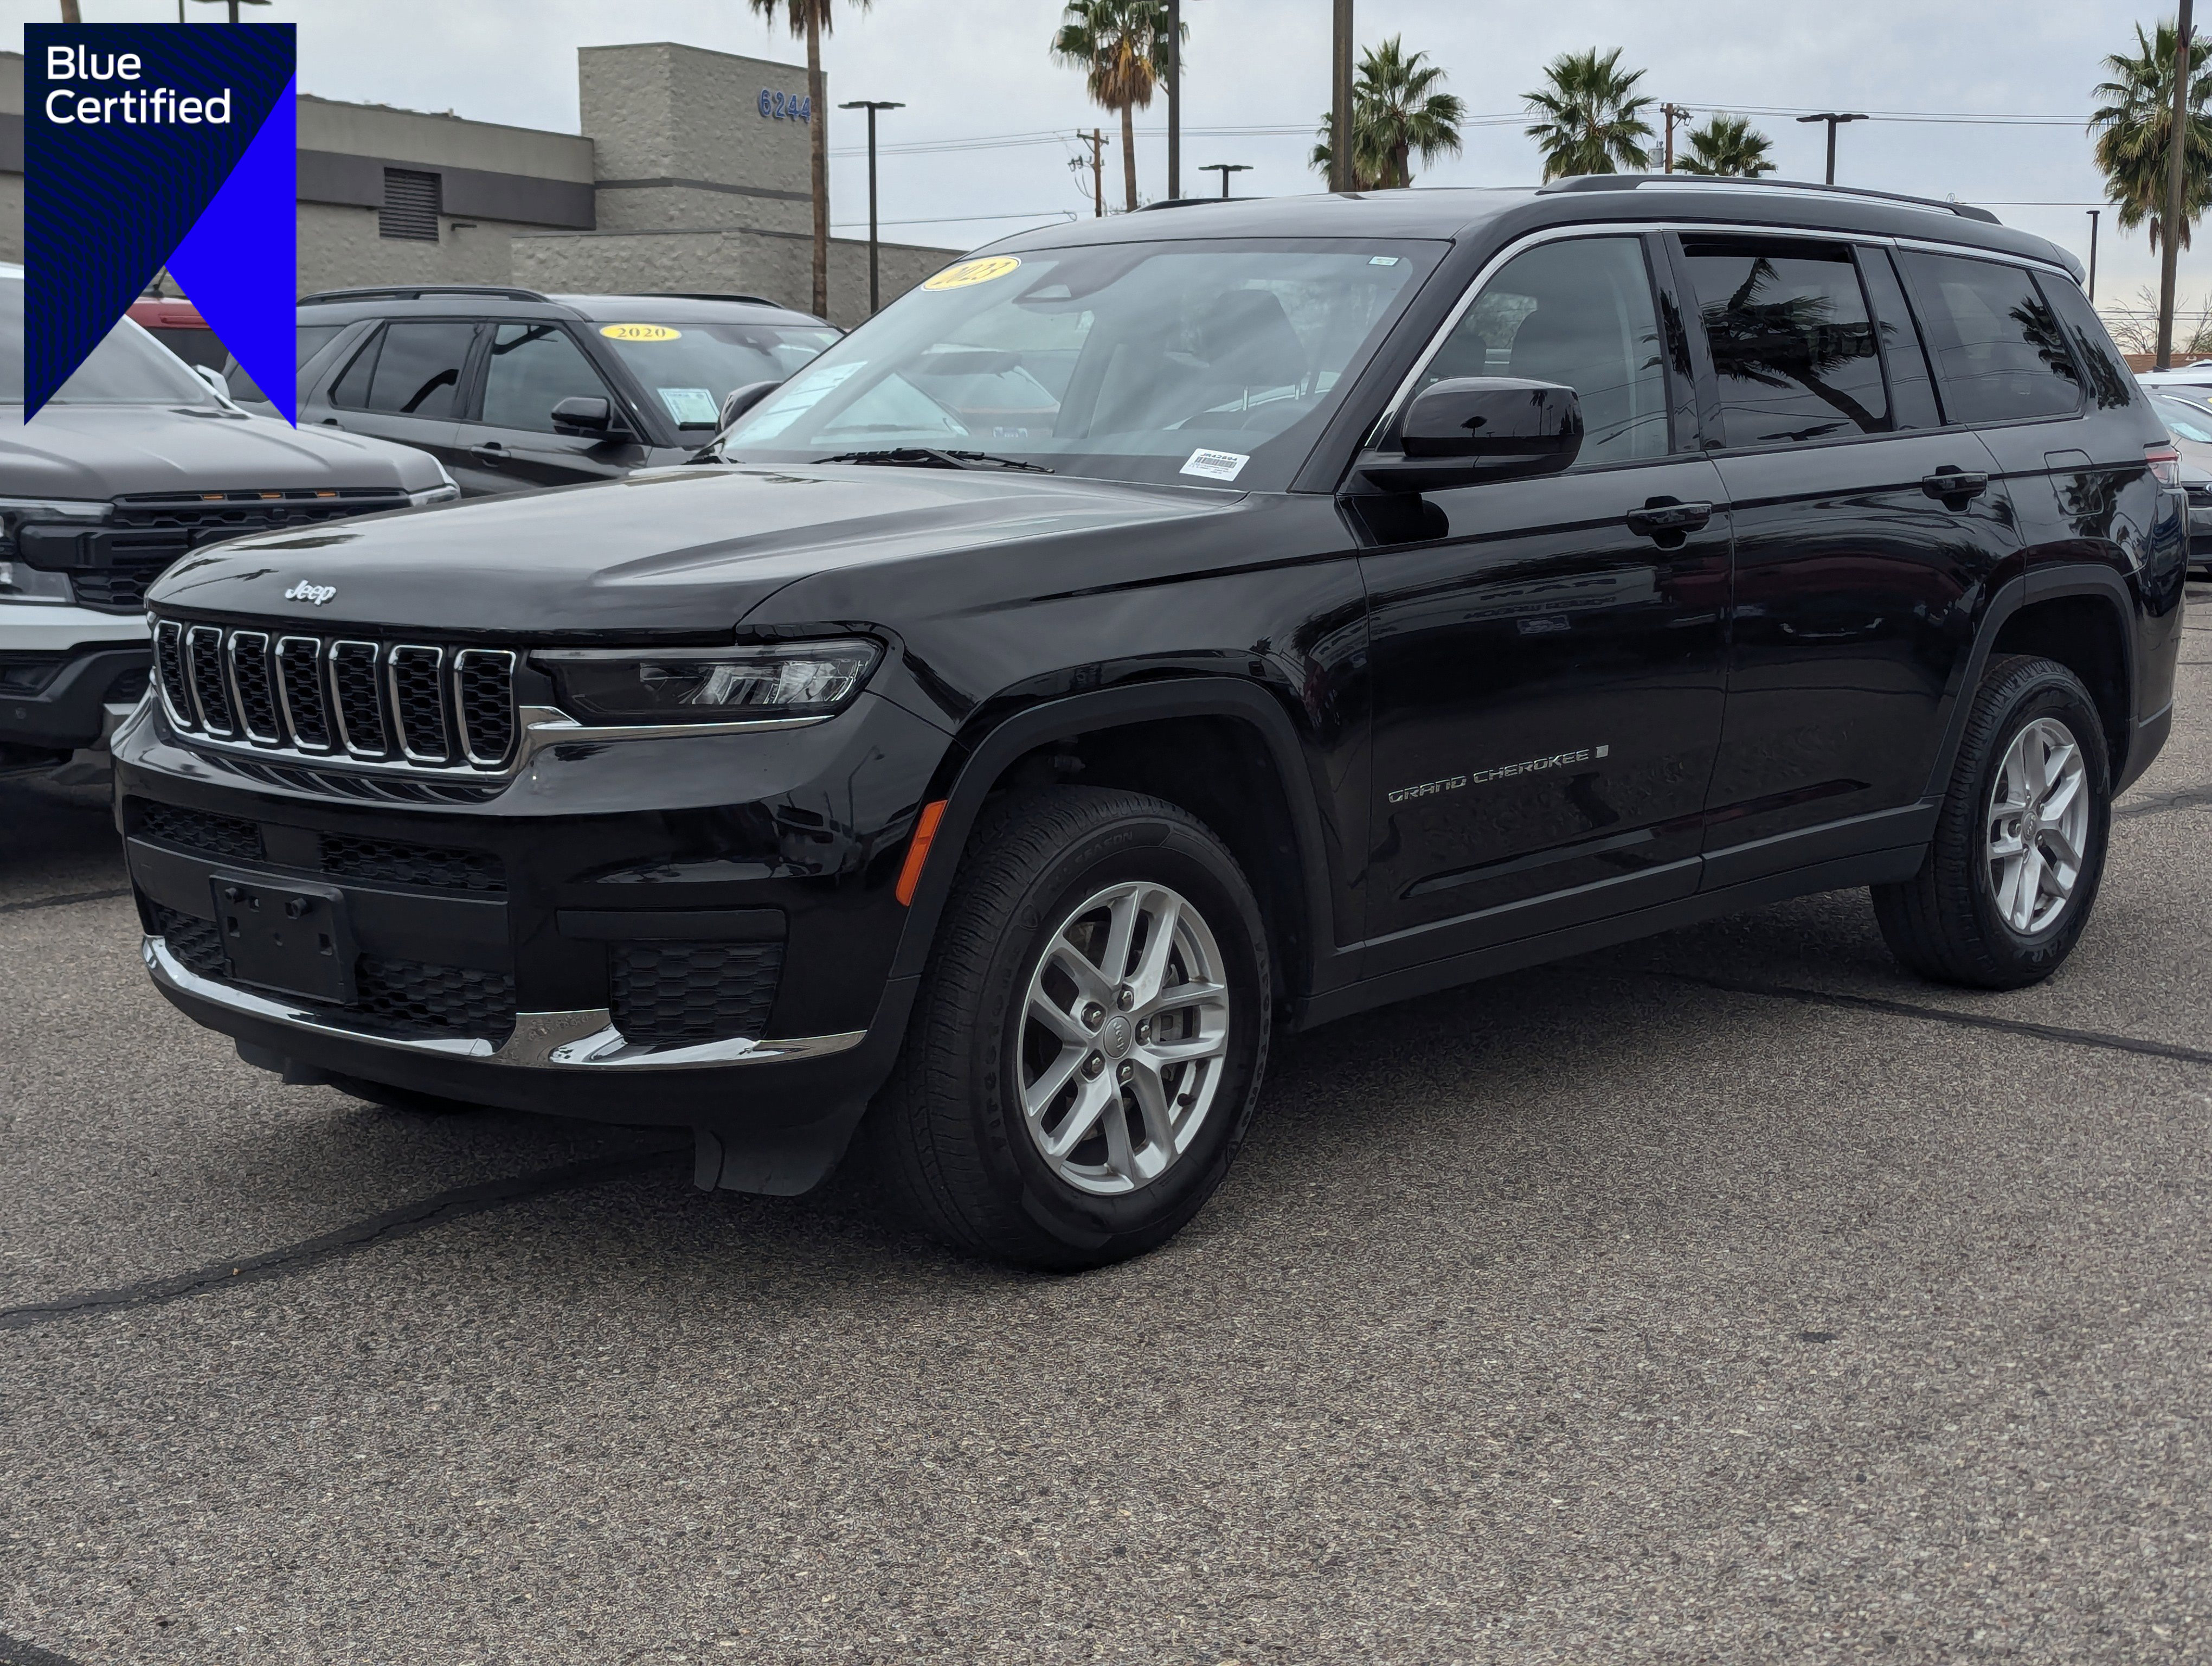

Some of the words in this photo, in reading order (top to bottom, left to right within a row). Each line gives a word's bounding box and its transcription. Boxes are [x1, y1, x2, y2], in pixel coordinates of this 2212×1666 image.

[760, 89, 811, 123] 6244
[617, 328, 666, 338] 2020
[285, 580, 337, 605] Jeep
[1388, 776, 1467, 803] GRAND
[1474, 748, 1590, 784] CHEROKEE
